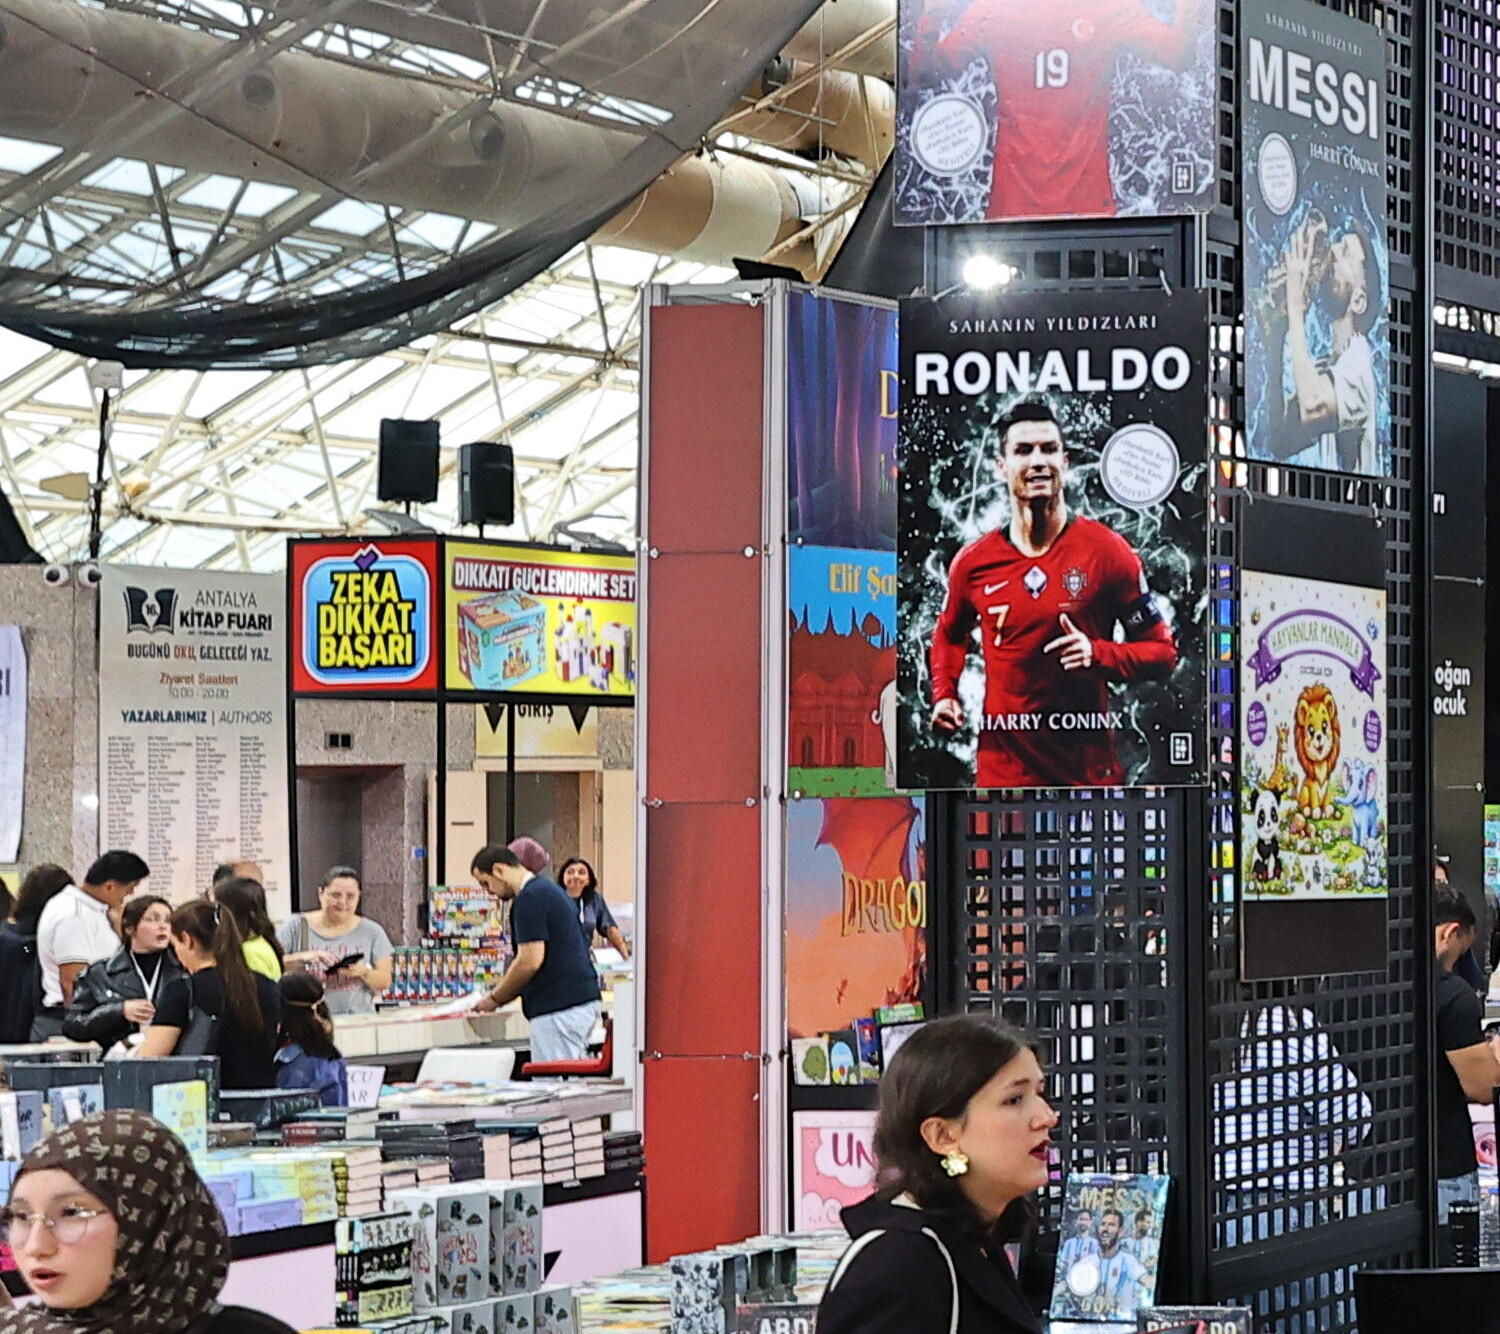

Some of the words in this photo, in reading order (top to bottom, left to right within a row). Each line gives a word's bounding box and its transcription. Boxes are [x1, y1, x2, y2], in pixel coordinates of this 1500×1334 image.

[1034, 48, 1069, 89] 19
[1248, 37, 1379, 140] MESSI
[1309, 141, 1342, 165] HARRY
[949, 318, 1036, 335] SAHANIN
[1046, 314, 1157, 332] YILDIZLARI
[914, 345, 1192, 396] RONALDO
[331, 571, 400, 604] ZEKA
[829, 562, 862, 594] Elif
[866, 565, 898, 602] Şa
[195, 589, 258, 609] ANTALYA
[179, 607, 225, 629] KİTAP
[227, 612, 273, 631] FUARI
[986, 604, 1010, 647] 7
[127, 642, 171, 658] BUGÜNÜ
[199, 643, 248, 662] GELECEĞİ
[319, 634, 413, 670] BAŞARI
[1434, 659, 1471, 692] oğan
[121, 708, 208, 724] YAZARLARIMIZ
[218, 710, 273, 725] AUTHORS
[1433, 690, 1467, 716] ocuk
[979, 712, 1042, 731] HARRY
[1048, 712, 1124, 731] CONINX
[841, 870, 927, 938] DRAGO
[1078, 1186, 1154, 1212] MESSI
